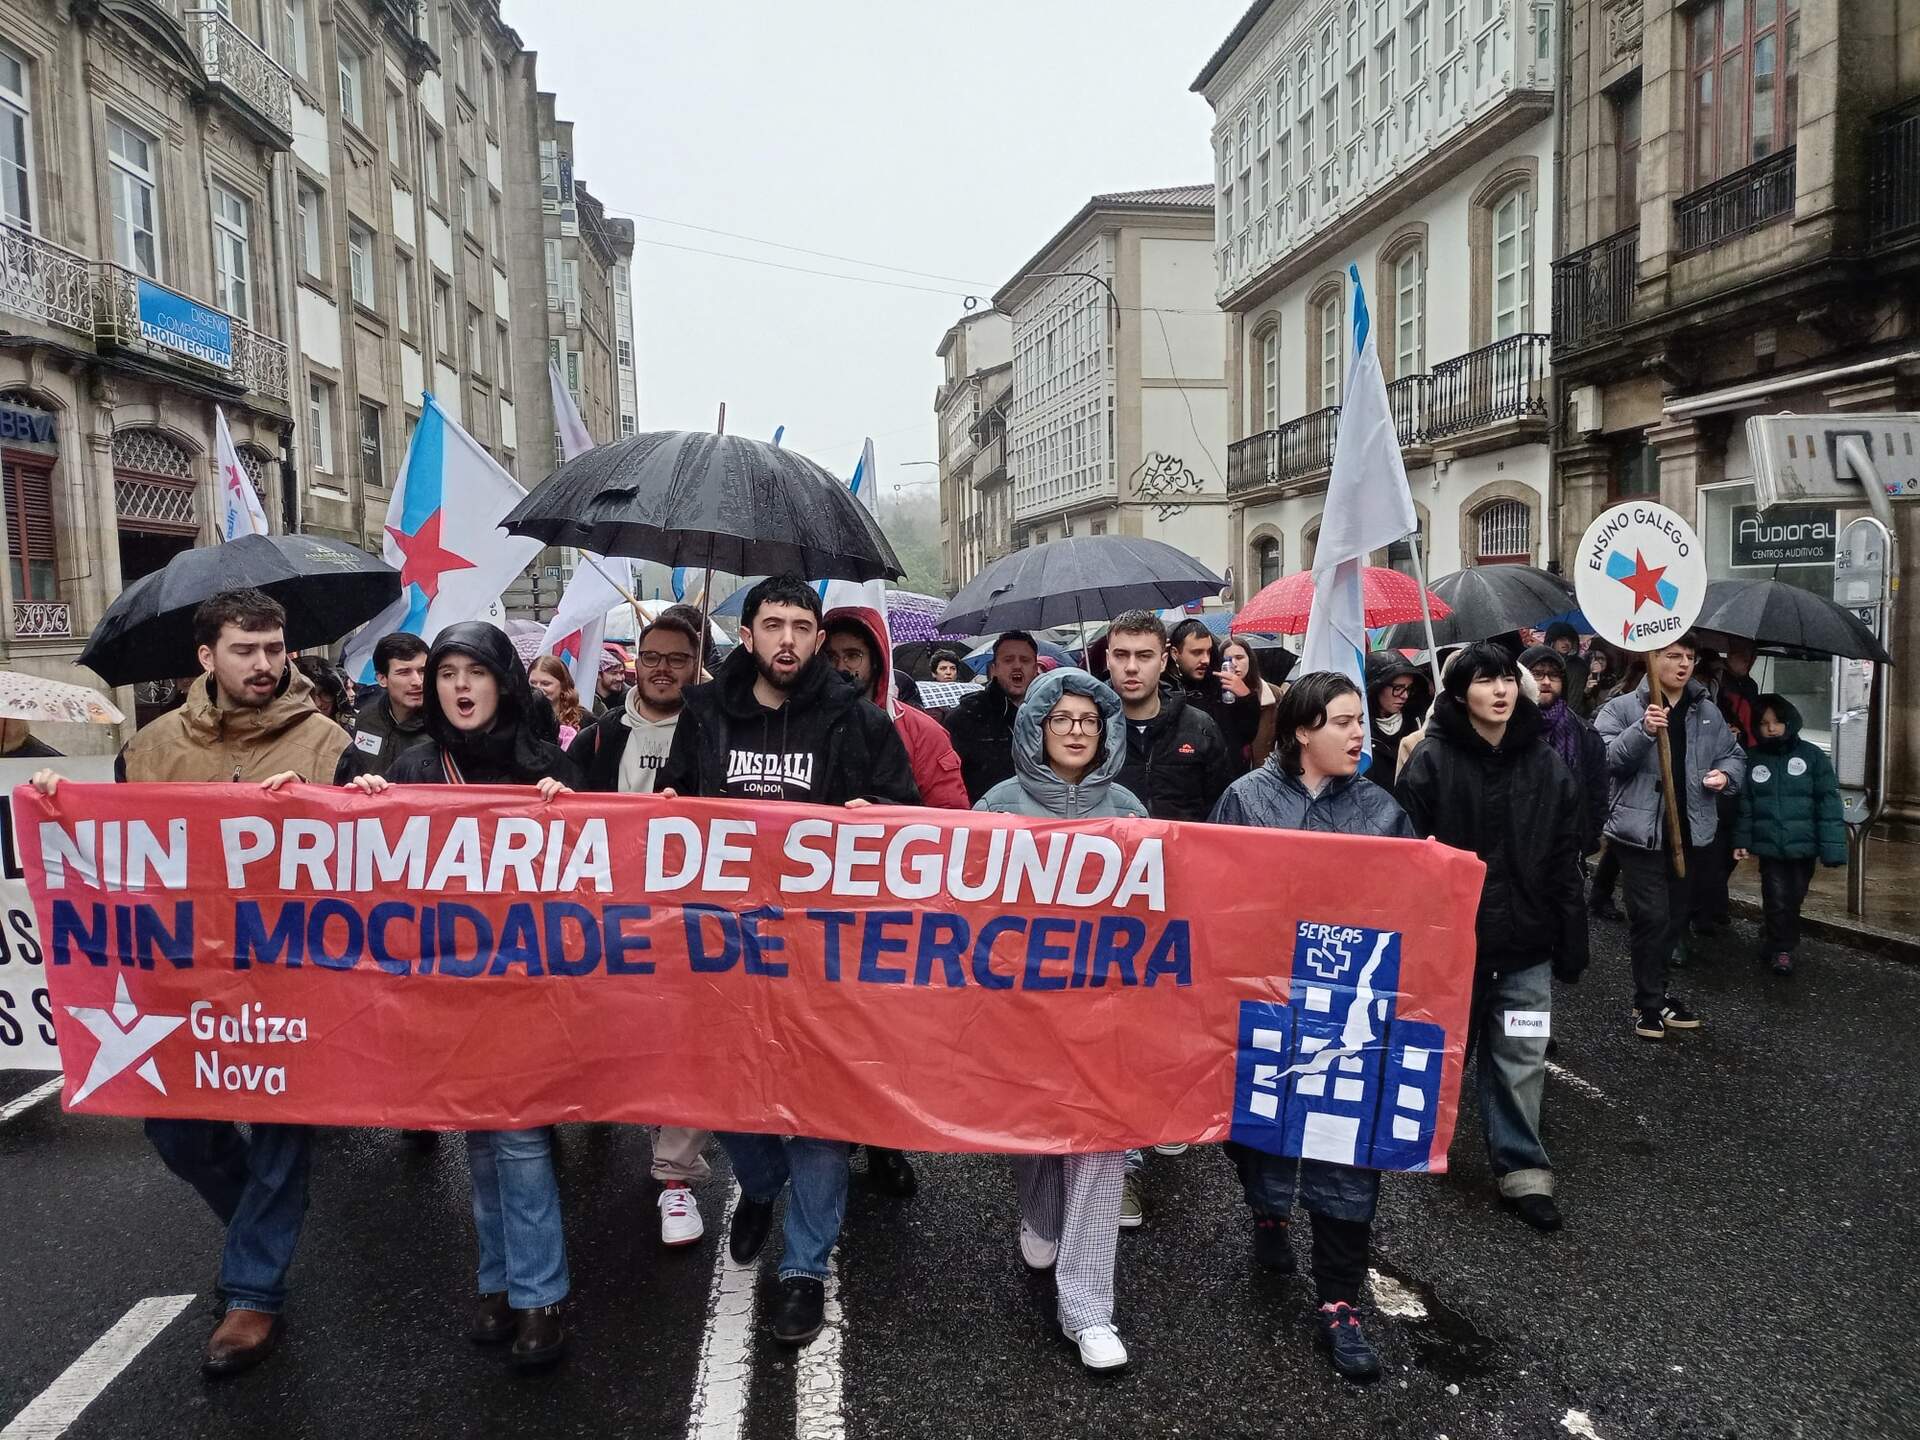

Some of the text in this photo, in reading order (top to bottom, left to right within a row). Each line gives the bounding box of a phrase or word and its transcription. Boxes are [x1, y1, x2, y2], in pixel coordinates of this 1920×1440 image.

[158, 312, 229, 352] COMPOSTELA
[191, 307, 228, 335] DISEÑO
[142, 322, 230, 367] ARQUITECTURA
[0, 411, 57, 443] BBVA
[1589, 508, 1689, 571] ENSINO GALEGO
[1752, 546, 1824, 560] CENTROS AUDITIVOS
[1636, 616, 1682, 638] ERGUER
[726, 749, 813, 784] ONSDAL
[39, 815, 1166, 912] NIN PRIMARIA DE SEGUNDA
[52, 898, 1192, 990] NIN MOCIDADE DE TERCEIRA
[1298, 922, 1364, 944] SERGAS
[190, 1000, 308, 1045] Galiza
[195, 1050, 287, 1095] Nova
